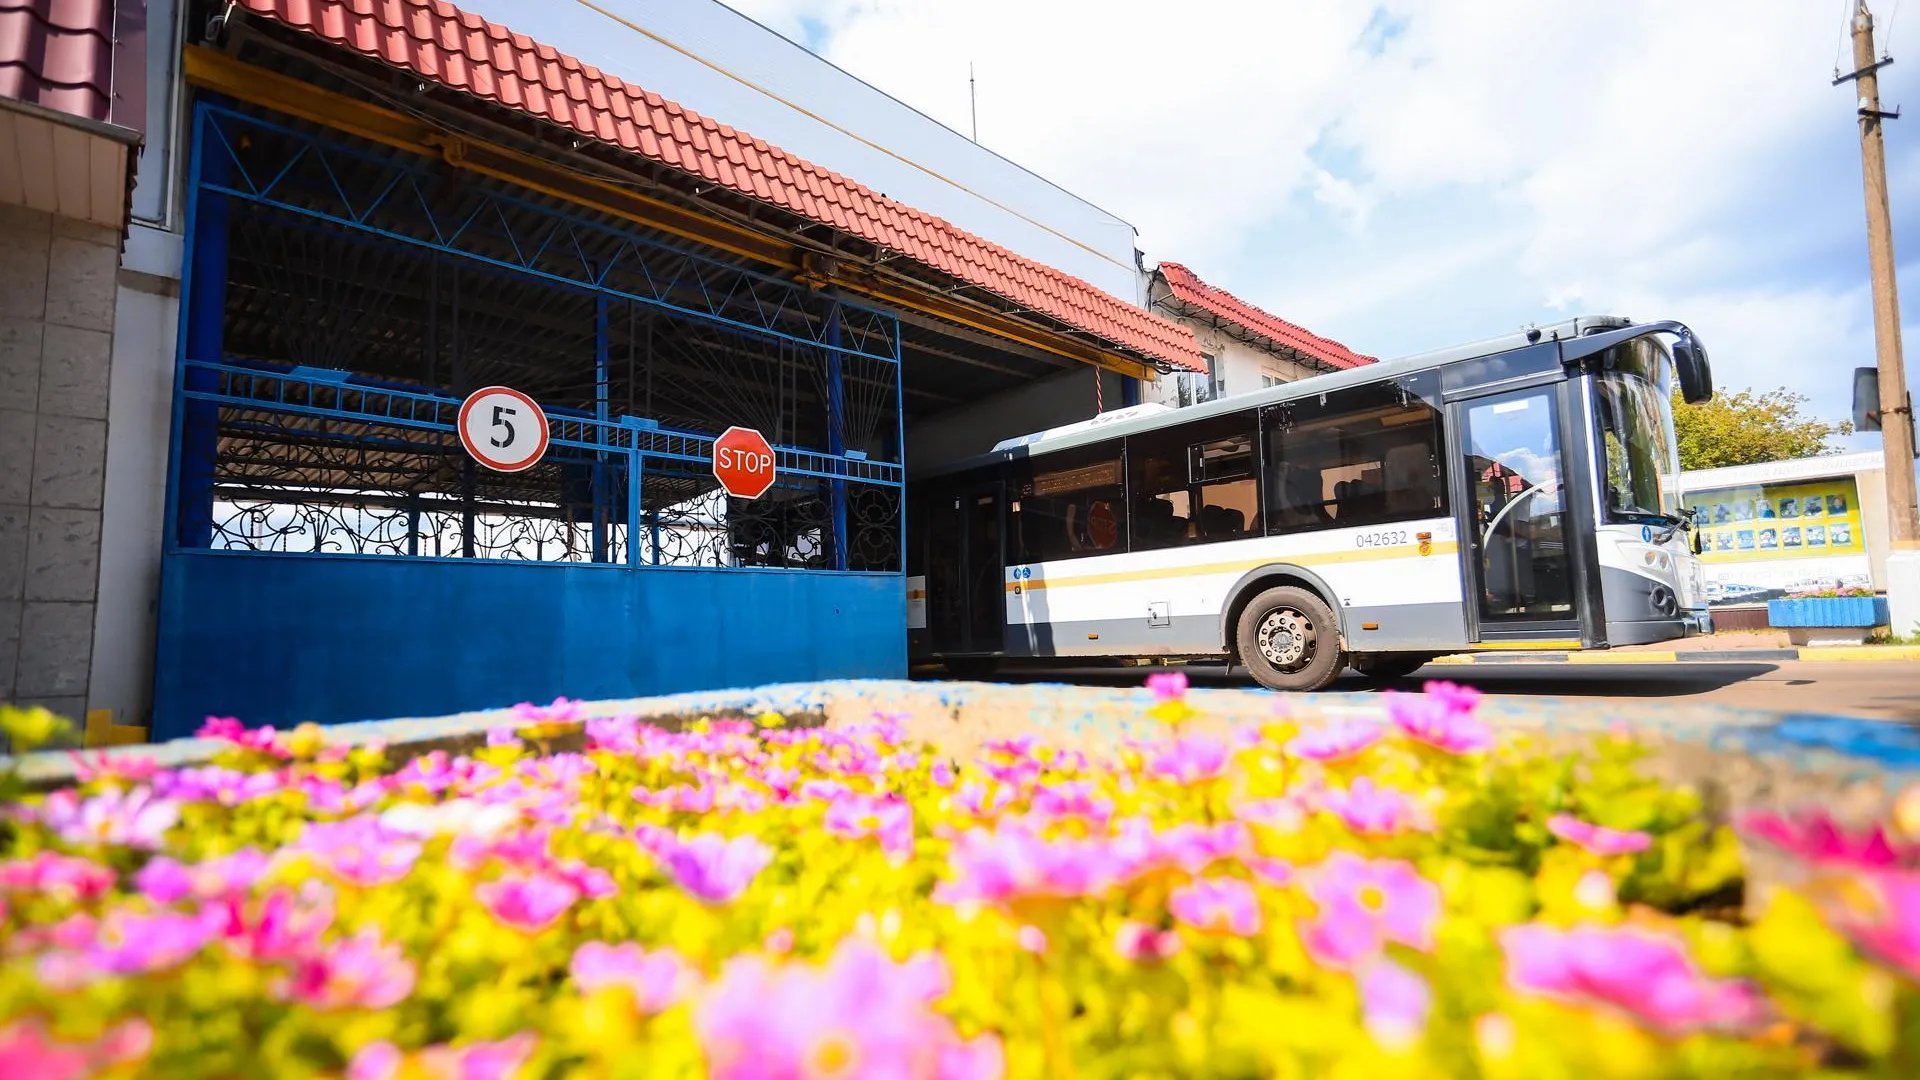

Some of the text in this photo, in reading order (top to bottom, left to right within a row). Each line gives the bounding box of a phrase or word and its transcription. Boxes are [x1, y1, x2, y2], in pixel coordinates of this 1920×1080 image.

[490, 405, 517, 449] 5
[719, 447, 772, 475] STOP
[1356, 530, 1407, 548] 042632
